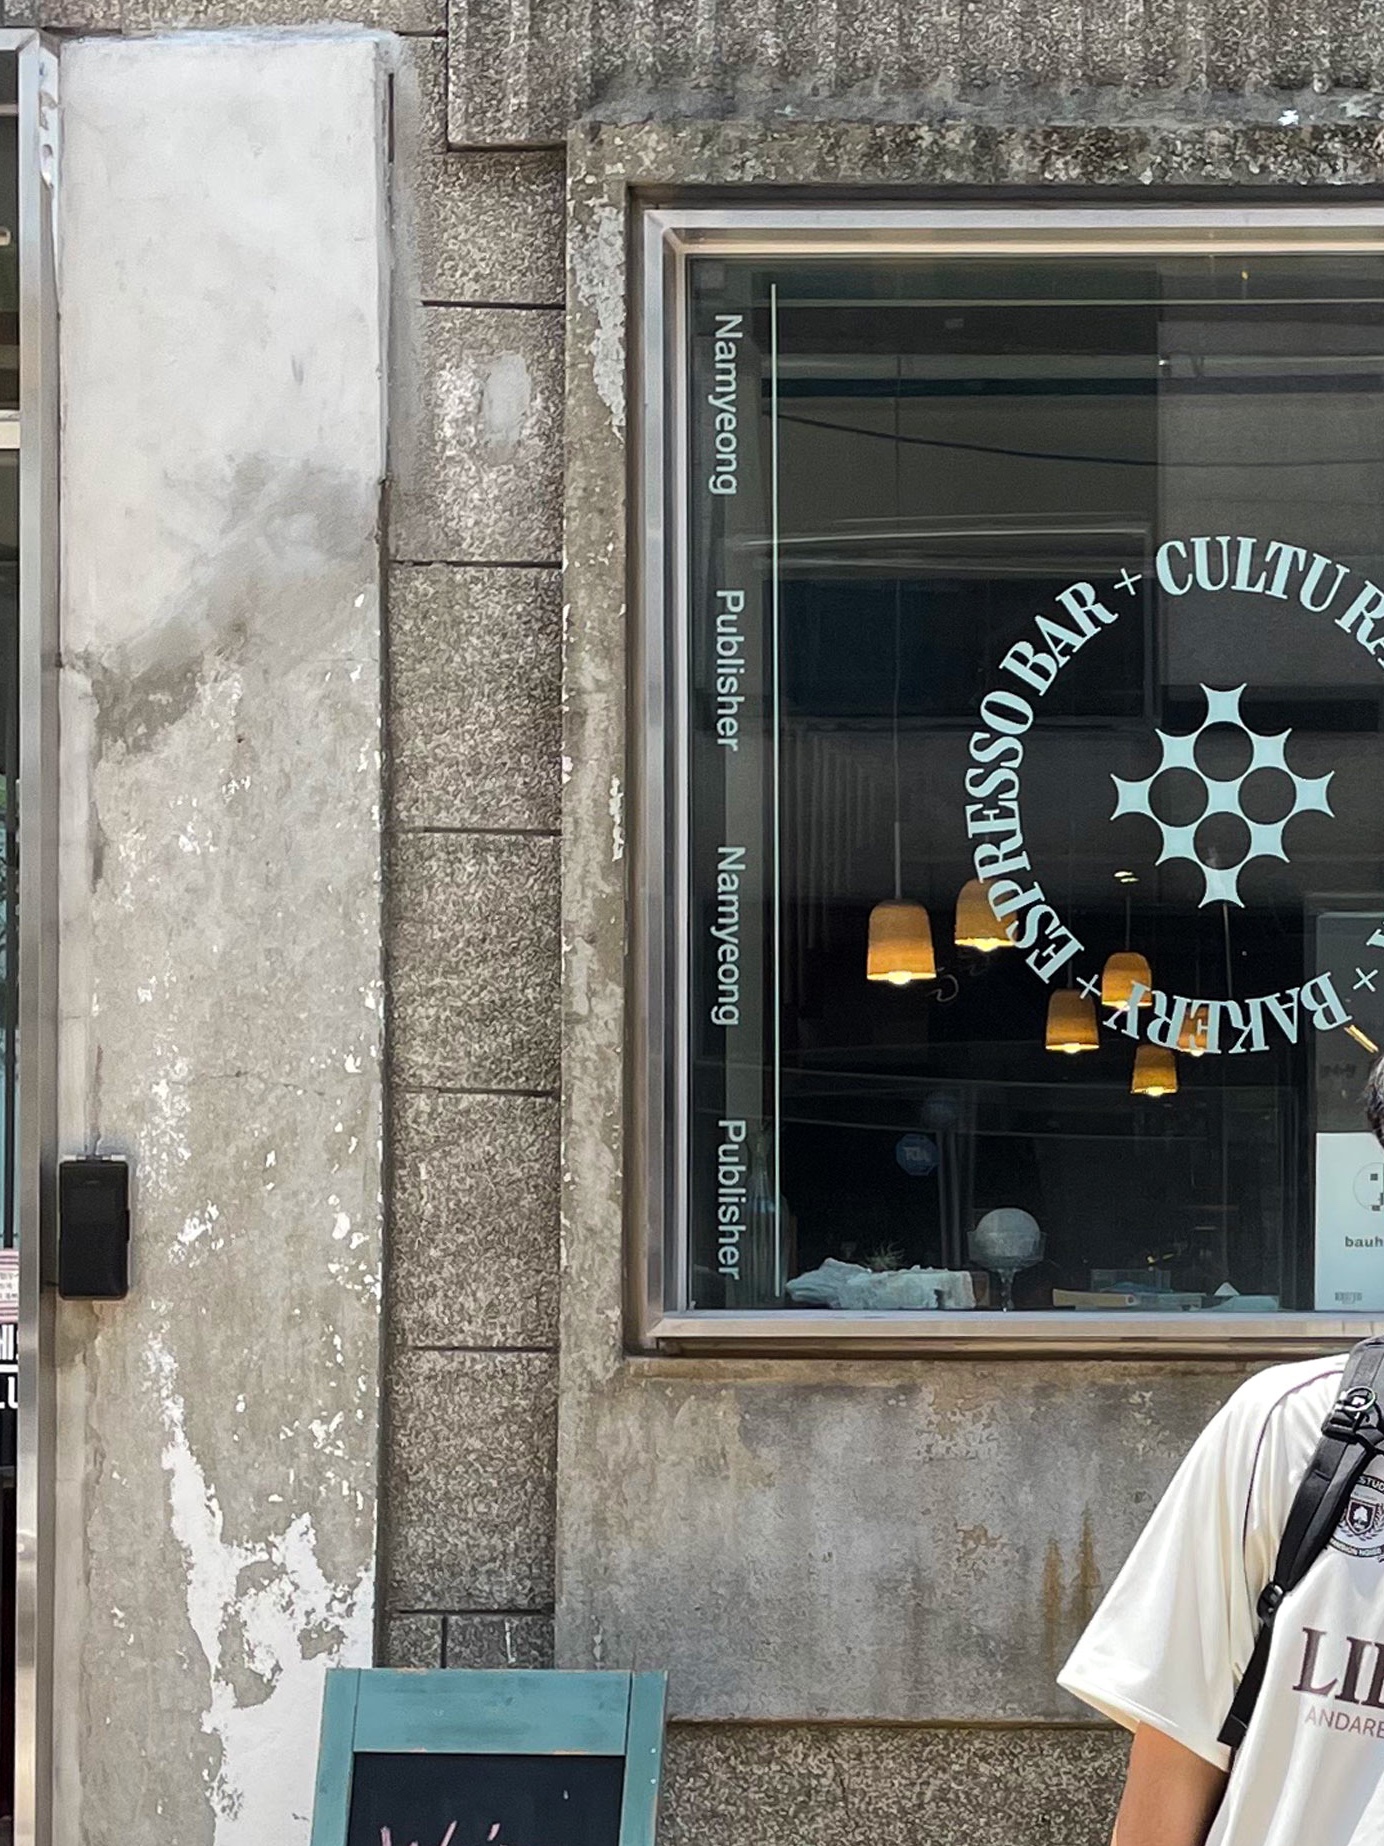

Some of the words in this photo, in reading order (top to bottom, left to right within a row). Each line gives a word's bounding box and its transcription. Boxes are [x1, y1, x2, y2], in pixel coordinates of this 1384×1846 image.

[708, 314, 743, 495] Namyeong
[716, 590, 745, 751] Publisher
[999, 580, 1119, 697] BAR
[964, 690, 1085, 984] ESPRESSO
[710, 847, 746, 1026] Namyeong
[1102, 972, 1352, 1055] BAKERY
[718, 1120, 747, 1280] Publisher
